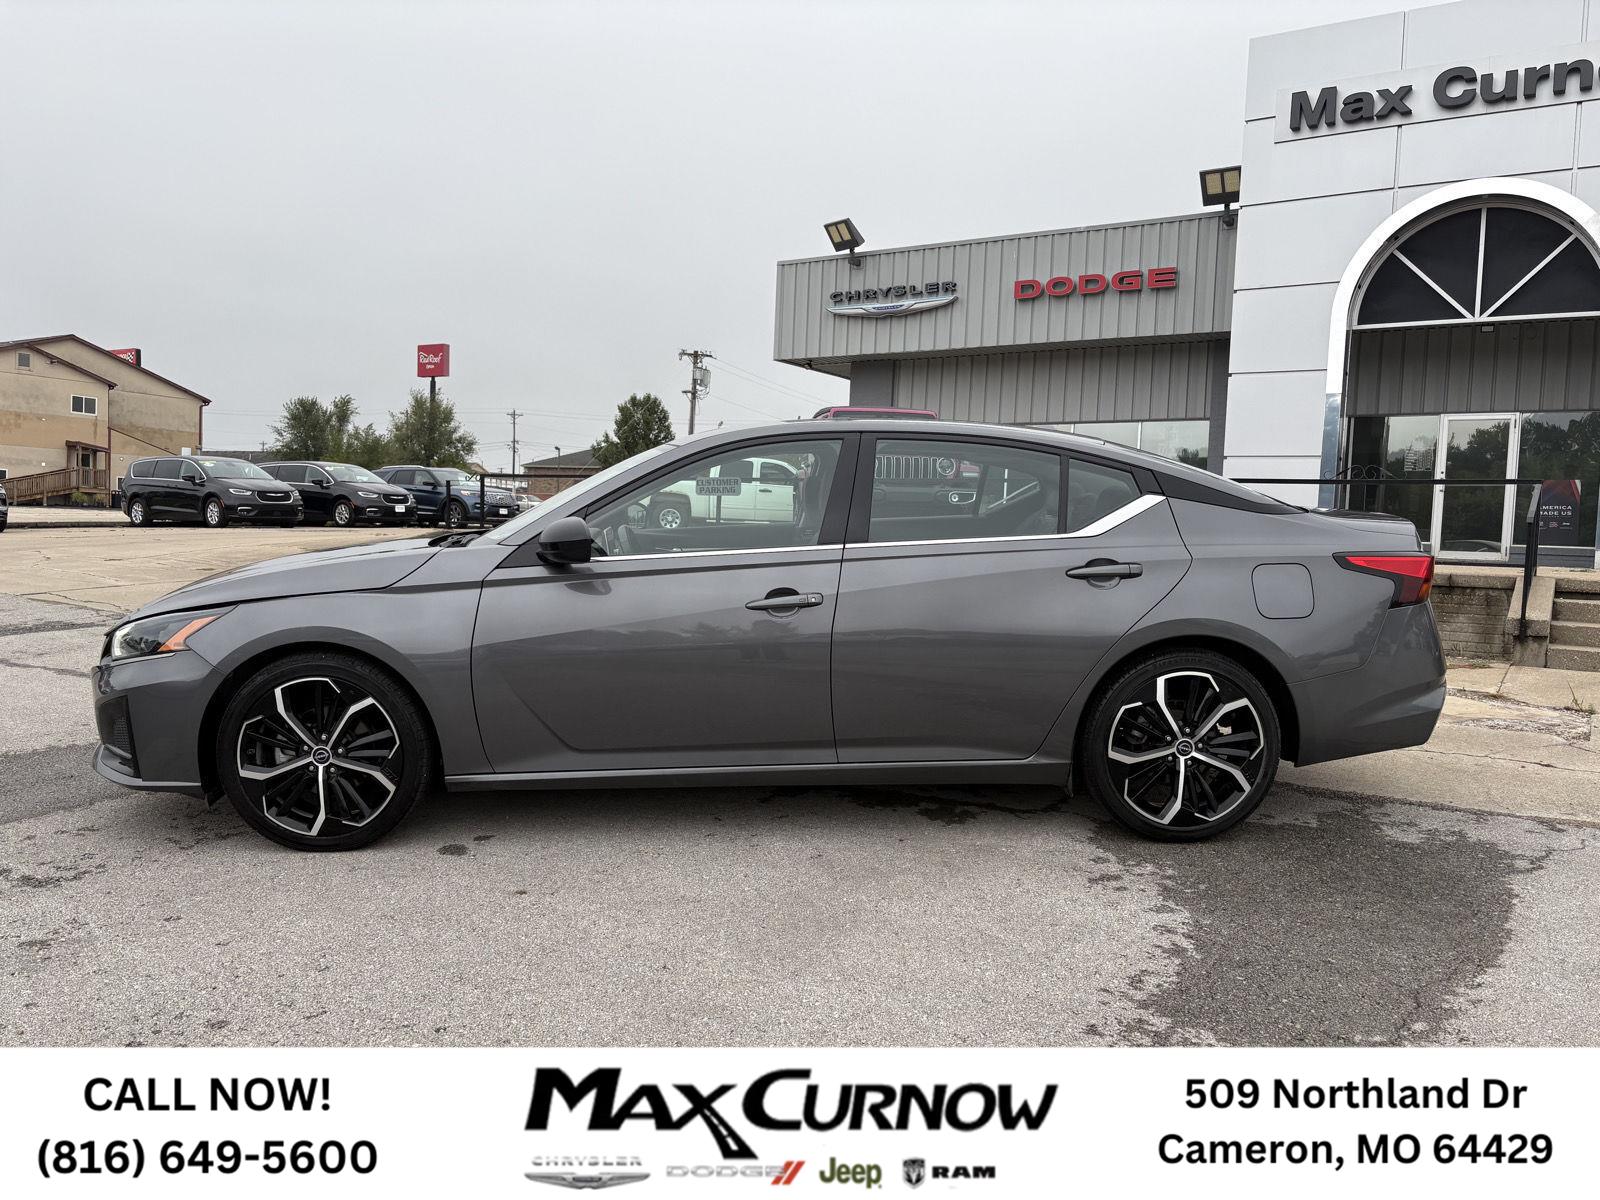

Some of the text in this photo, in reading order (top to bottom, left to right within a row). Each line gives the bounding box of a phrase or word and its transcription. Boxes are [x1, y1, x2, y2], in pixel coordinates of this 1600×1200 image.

[1289, 85, 1413, 132] Max
[829, 281, 958, 303] CHRYSLER
[1013, 267, 1178, 300] DODGE
